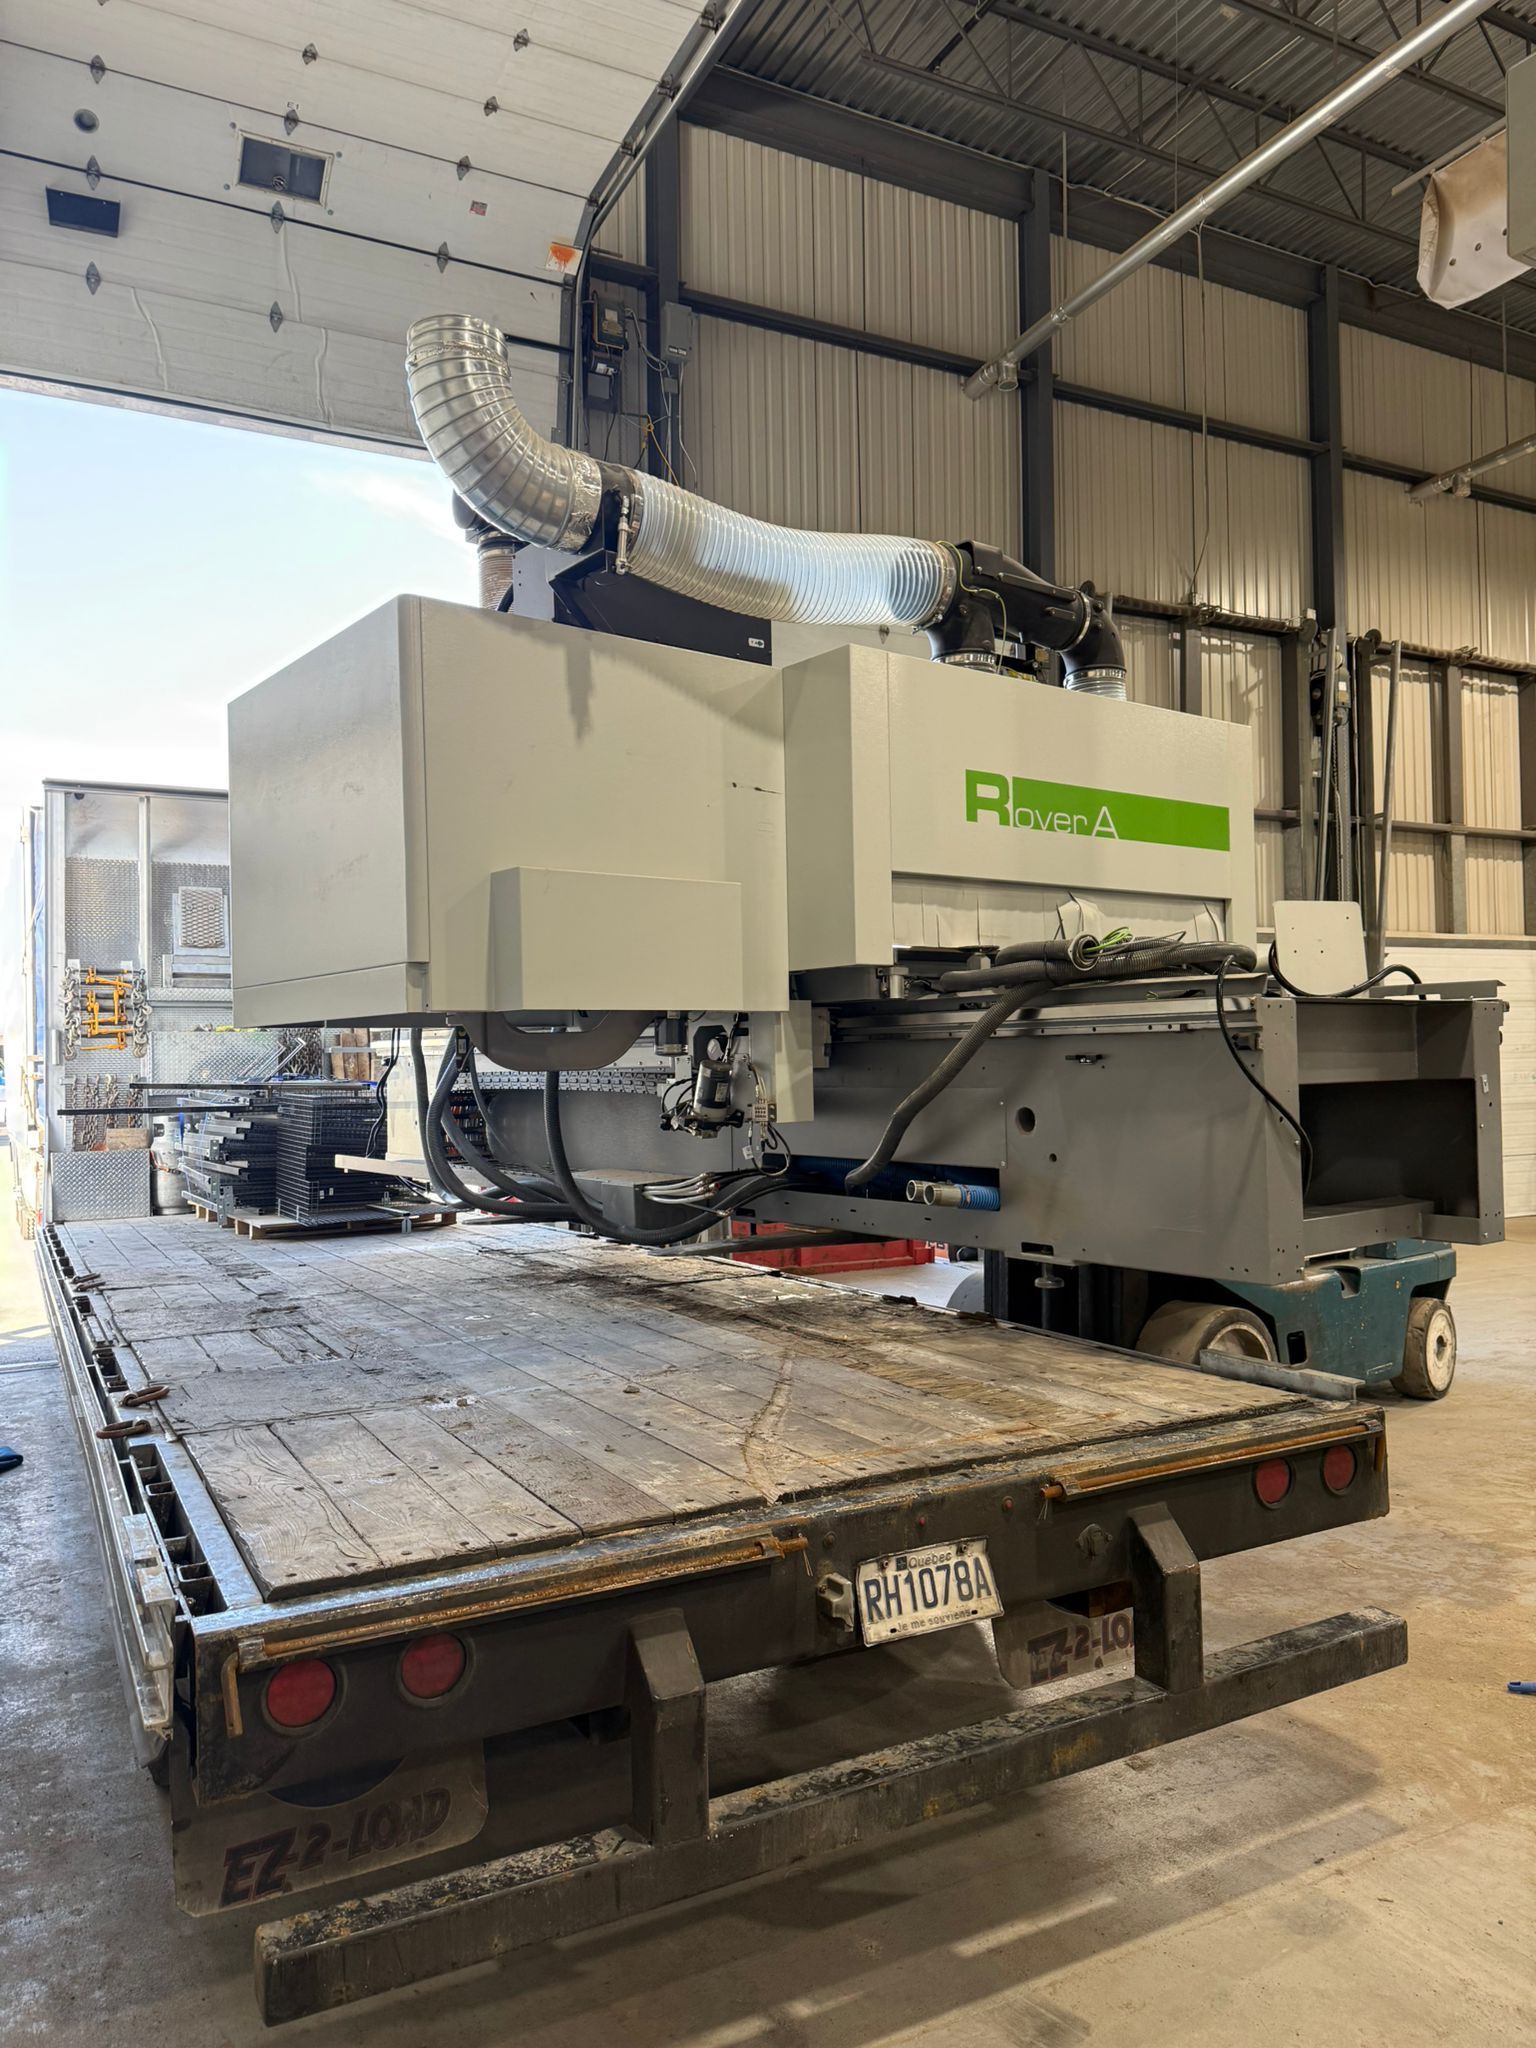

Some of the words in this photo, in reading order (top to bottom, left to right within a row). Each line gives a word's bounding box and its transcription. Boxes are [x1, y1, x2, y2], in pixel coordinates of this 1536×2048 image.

[965, 769, 1087, 835] Rover
[1091, 806, 1119, 839] A
[908, 1552, 952, 1569] Québec
[864, 1556, 992, 1624] RH1078A
[911, 1619, 927, 1629] me
